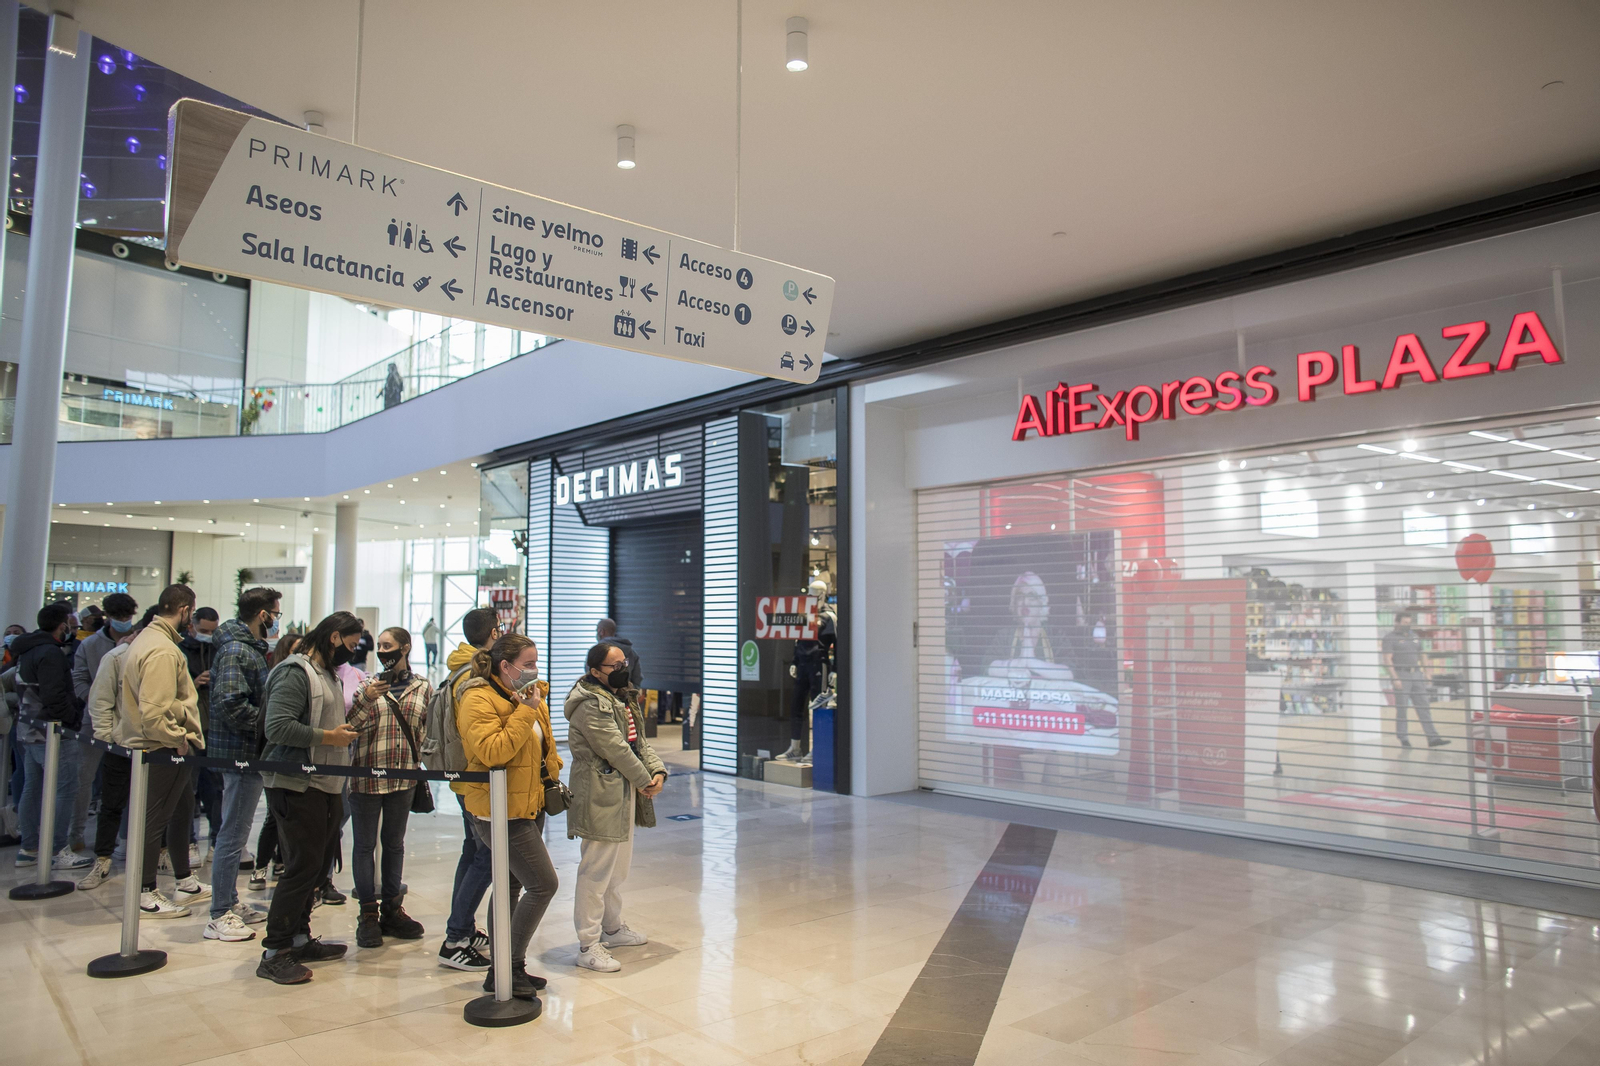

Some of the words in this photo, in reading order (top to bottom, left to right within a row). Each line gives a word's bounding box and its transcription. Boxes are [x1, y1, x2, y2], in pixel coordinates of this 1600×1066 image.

[246, 185, 322, 221] Aseos
[492, 205, 536, 231] cine
[541, 218, 604, 249] yelmo
[241, 232, 295, 264] Sala
[303, 245, 404, 287] lactancia
[490, 235, 536, 266] Lago
[541, 252, 553, 271] y
[573, 245, 603, 257] PREMIUM
[679, 253, 732, 281] Acceso
[488, 257, 613, 301] Restaurantes
[485, 287, 574, 322] Ascensor
[677, 289, 730, 317] Acceso
[675, 326, 706, 348] Taxi
[1011, 364, 1278, 442] AliExpress
[1297, 310, 1562, 402] PLAZA
[103, 388, 174, 410] PRIMARK
[555, 453, 683, 506] DECIMAS
[51, 580, 128, 593] PRIMARK
[756, 597, 817, 638] SALE
[1030, 693, 1073, 705] ROSA
